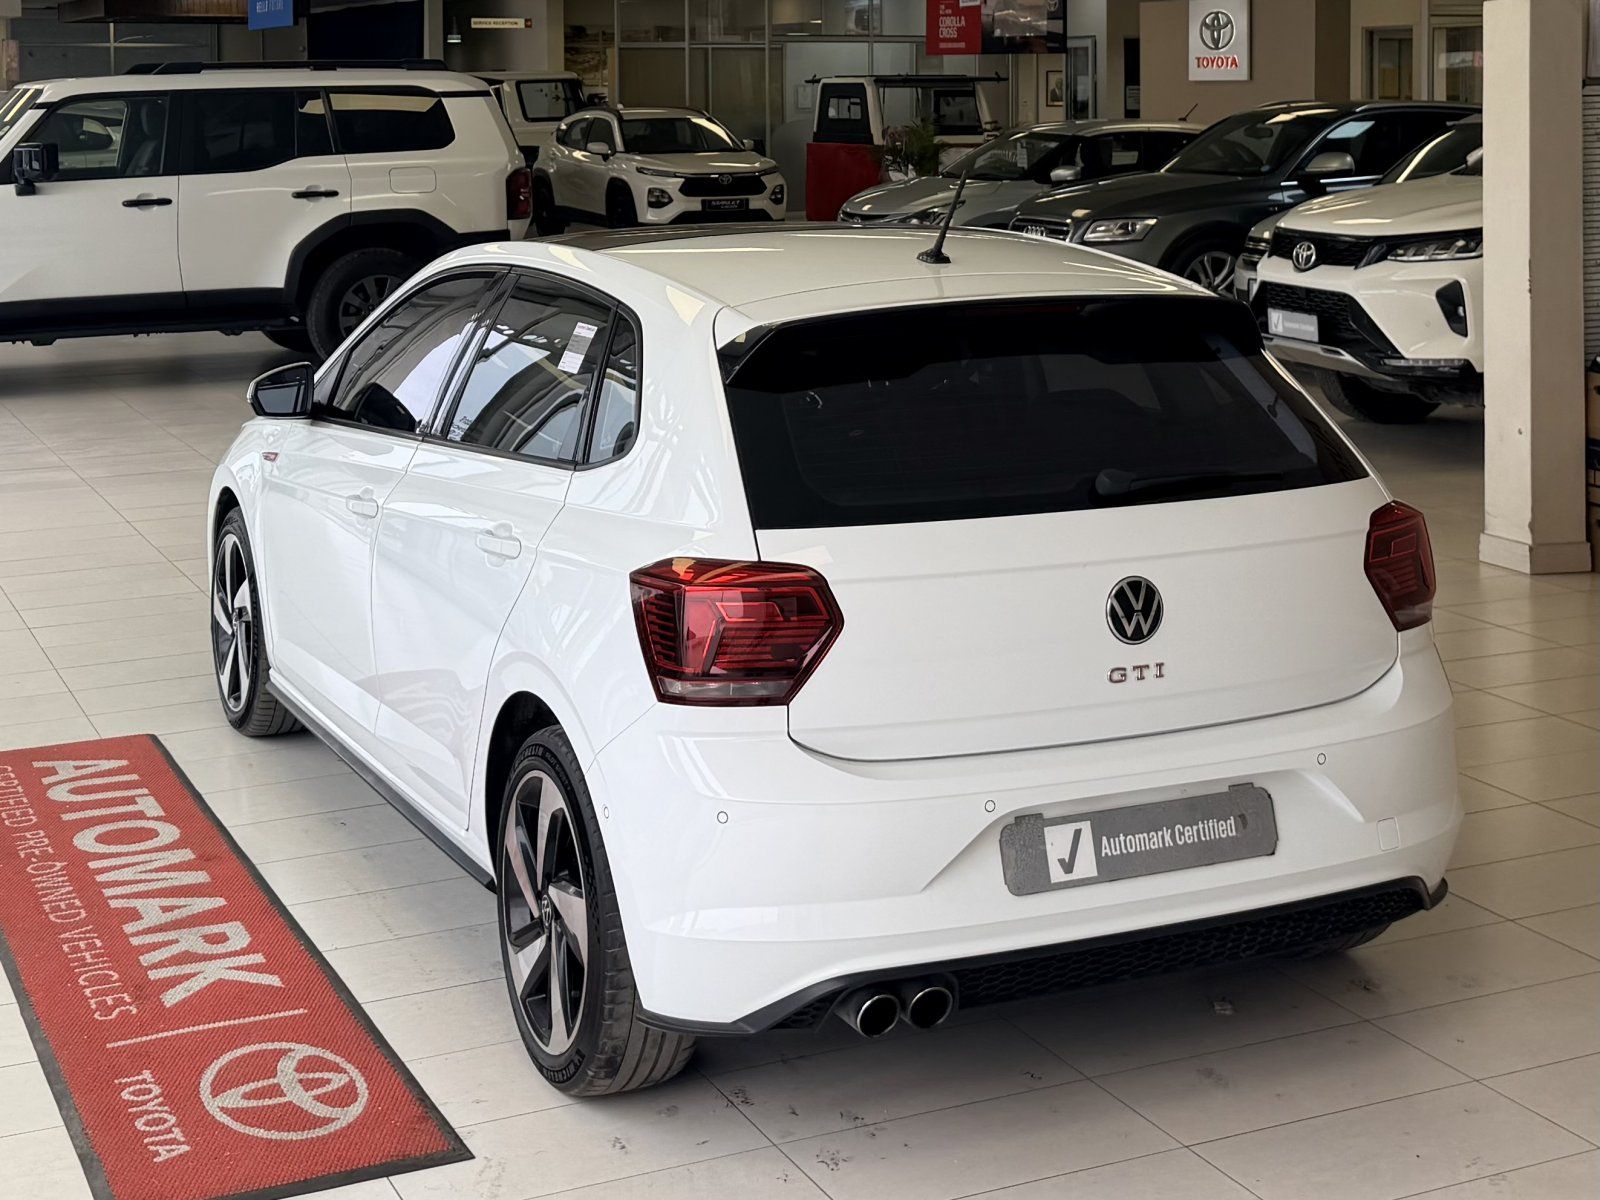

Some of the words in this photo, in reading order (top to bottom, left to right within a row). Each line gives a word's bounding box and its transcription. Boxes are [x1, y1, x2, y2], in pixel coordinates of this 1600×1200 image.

[939, 16, 965, 27] COROLLA
[939, 27, 958, 38] CROSS
[1195, 55, 1238, 69] TOYOTA
[1107, 662, 1165, 683] GTI
[1101, 827, 1173, 857] Automark
[1175, 816, 1236, 845] Certified
[32, 759, 285, 1008] AUTOMARK
[12, 830, 87, 922] PRE-OWNED
[58, 925, 137, 1020] VEHICLES
[114, 1069, 191, 1162] TOYOTA
